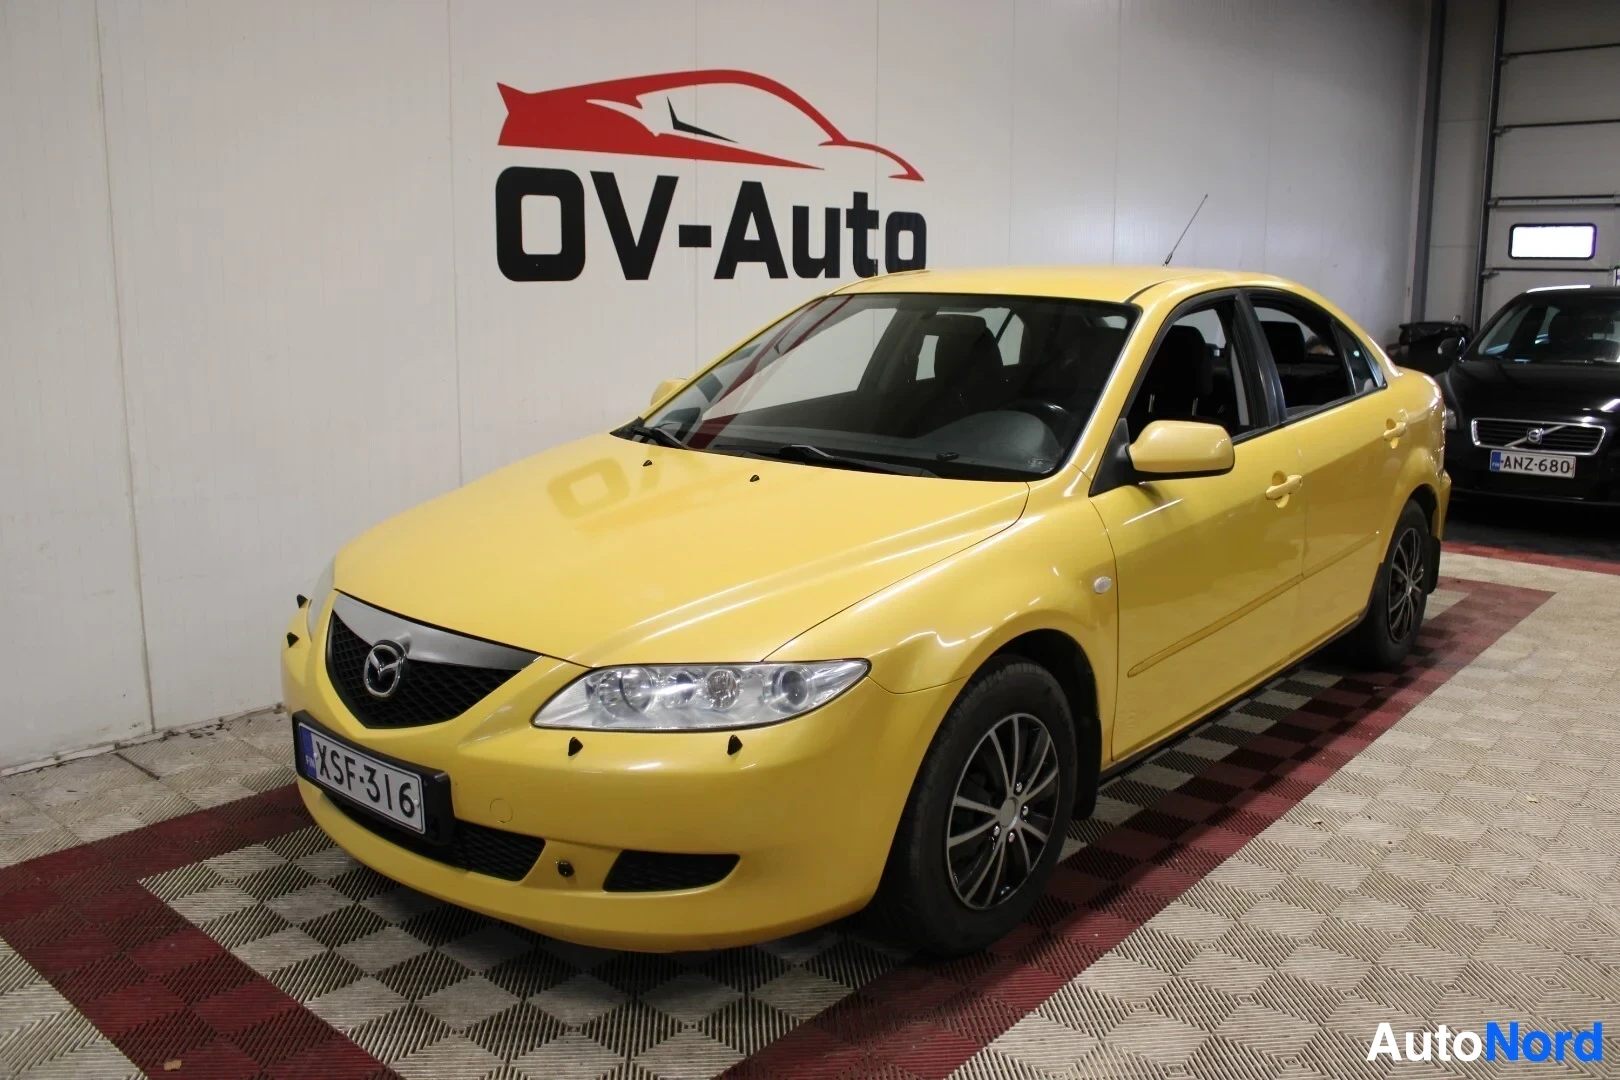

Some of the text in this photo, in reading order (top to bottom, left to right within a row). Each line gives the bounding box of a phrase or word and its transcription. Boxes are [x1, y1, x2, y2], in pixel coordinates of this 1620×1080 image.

[495, 166, 927, 282] OV-Auto
[1503, 455, 1570, 474] ANZ-680
[316, 741, 415, 819] XSF-316
